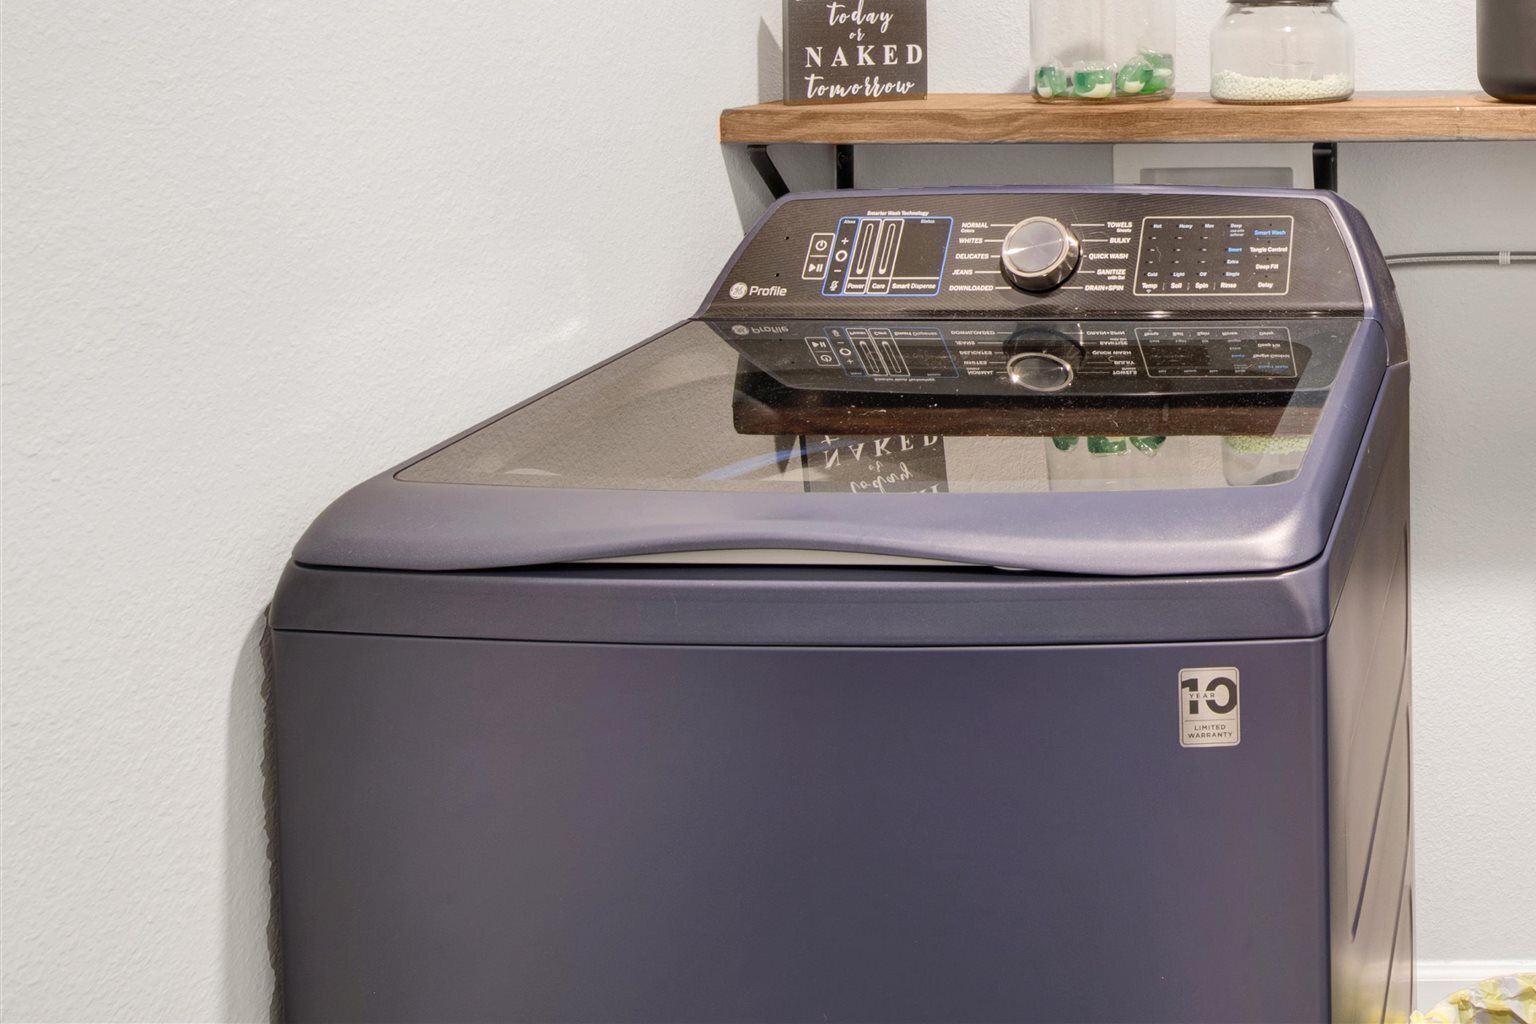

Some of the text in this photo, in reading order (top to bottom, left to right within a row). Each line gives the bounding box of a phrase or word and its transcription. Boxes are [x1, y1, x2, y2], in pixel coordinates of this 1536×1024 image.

[849, 28, 864, 41] or
[805, 44, 922, 67] NAKED
[805, 74, 915, 98] tomorrow
[749, 286, 787, 296] Profile
[1181, 677, 1237, 714] 10
